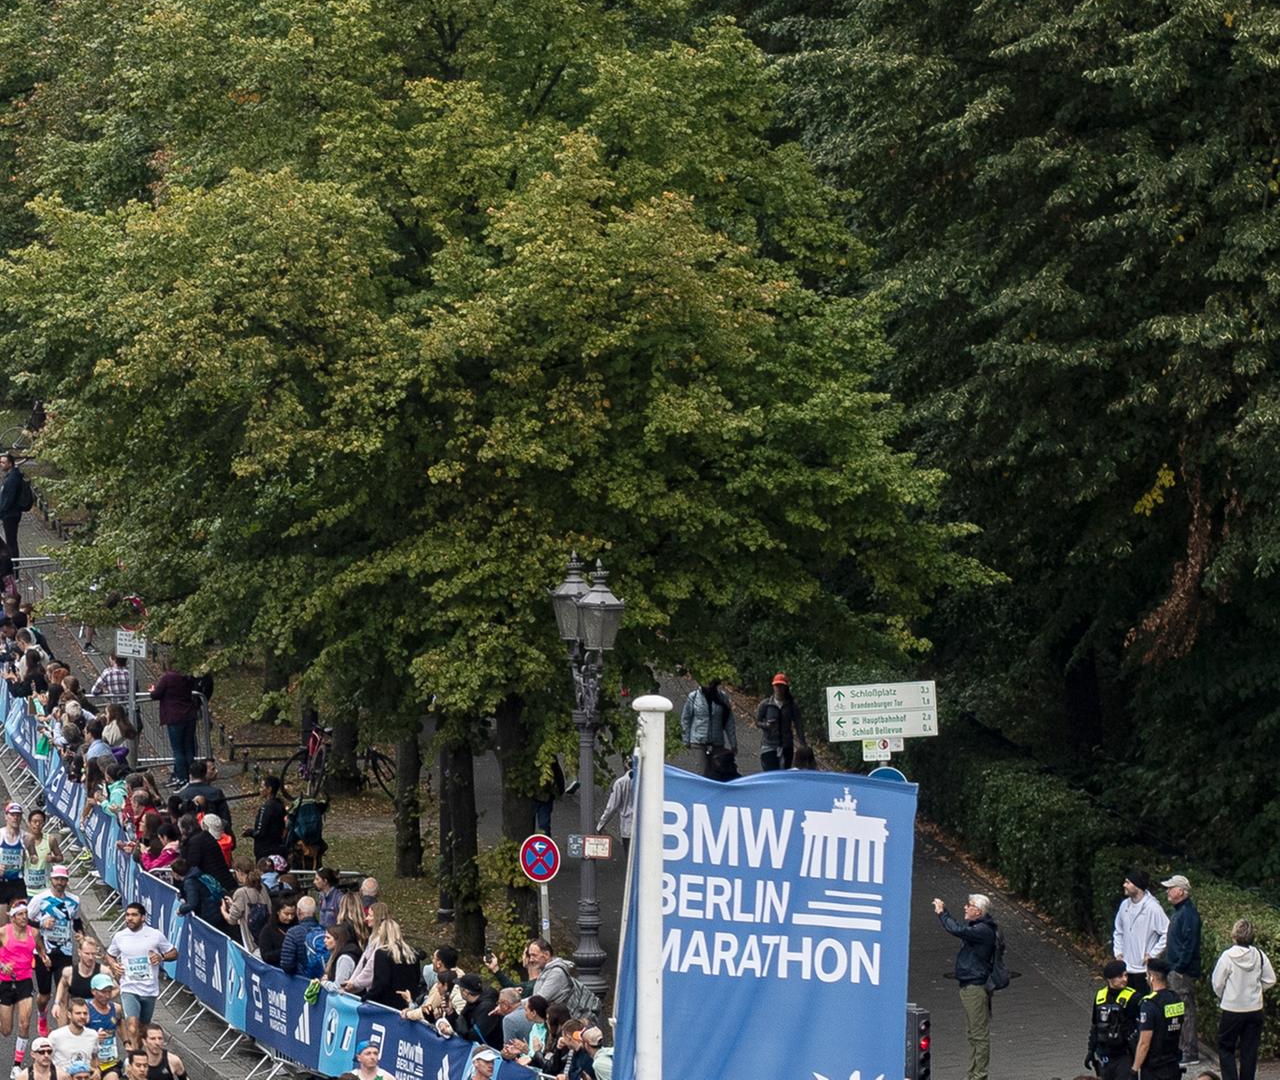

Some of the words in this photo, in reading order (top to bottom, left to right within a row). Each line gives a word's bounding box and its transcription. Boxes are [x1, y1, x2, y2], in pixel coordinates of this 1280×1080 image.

[850, 689, 897, 699] Schloßplatz
[862, 715, 907, 725] Hauptbahnhof
[662, 800, 795, 869] BMW
[661, 872, 790, 924] BERLIN
[661, 928, 881, 986] MARATHON
[398, 1039, 415, 1061] BMW
[396, 1056, 415, 1074] BERLIN
